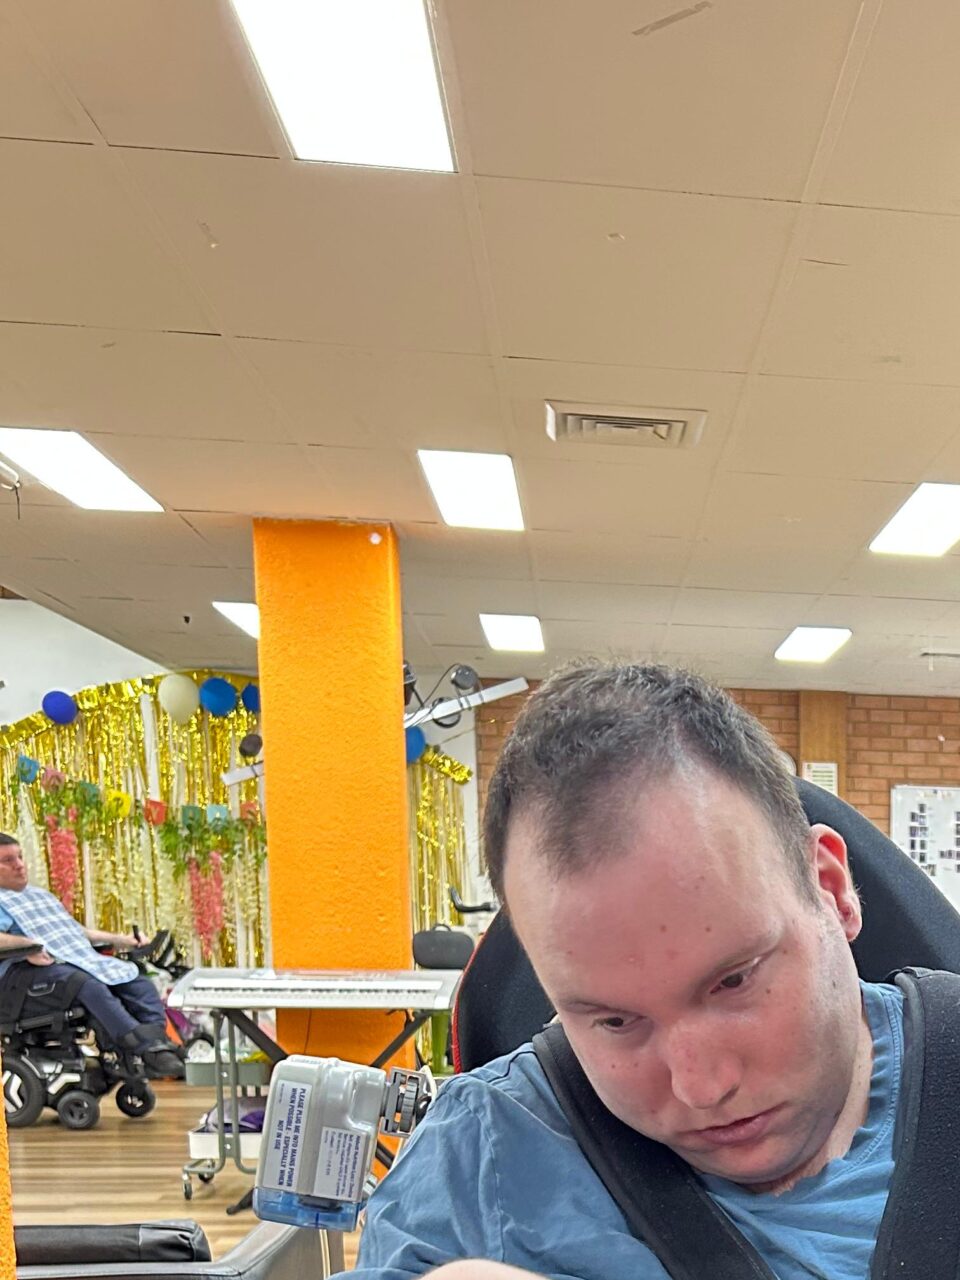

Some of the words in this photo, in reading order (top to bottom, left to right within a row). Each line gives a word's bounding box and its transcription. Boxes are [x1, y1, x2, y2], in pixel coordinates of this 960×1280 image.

[289, 1088, 297, 1104] WHEN
[297, 1088, 306, 1108] PLEASE
[286, 1104, 295, 1130] POSSIBLE
[294, 1110, 302, 1124] PLUG
[293, 1125, 301, 1133] ME
[291, 1134, 299, 1147] INTO
[280, 1136, 290, 1168] ESPECIALLY
[288, 1148, 297, 1166] MAINS
[286, 1167, 294, 1187] POWER
